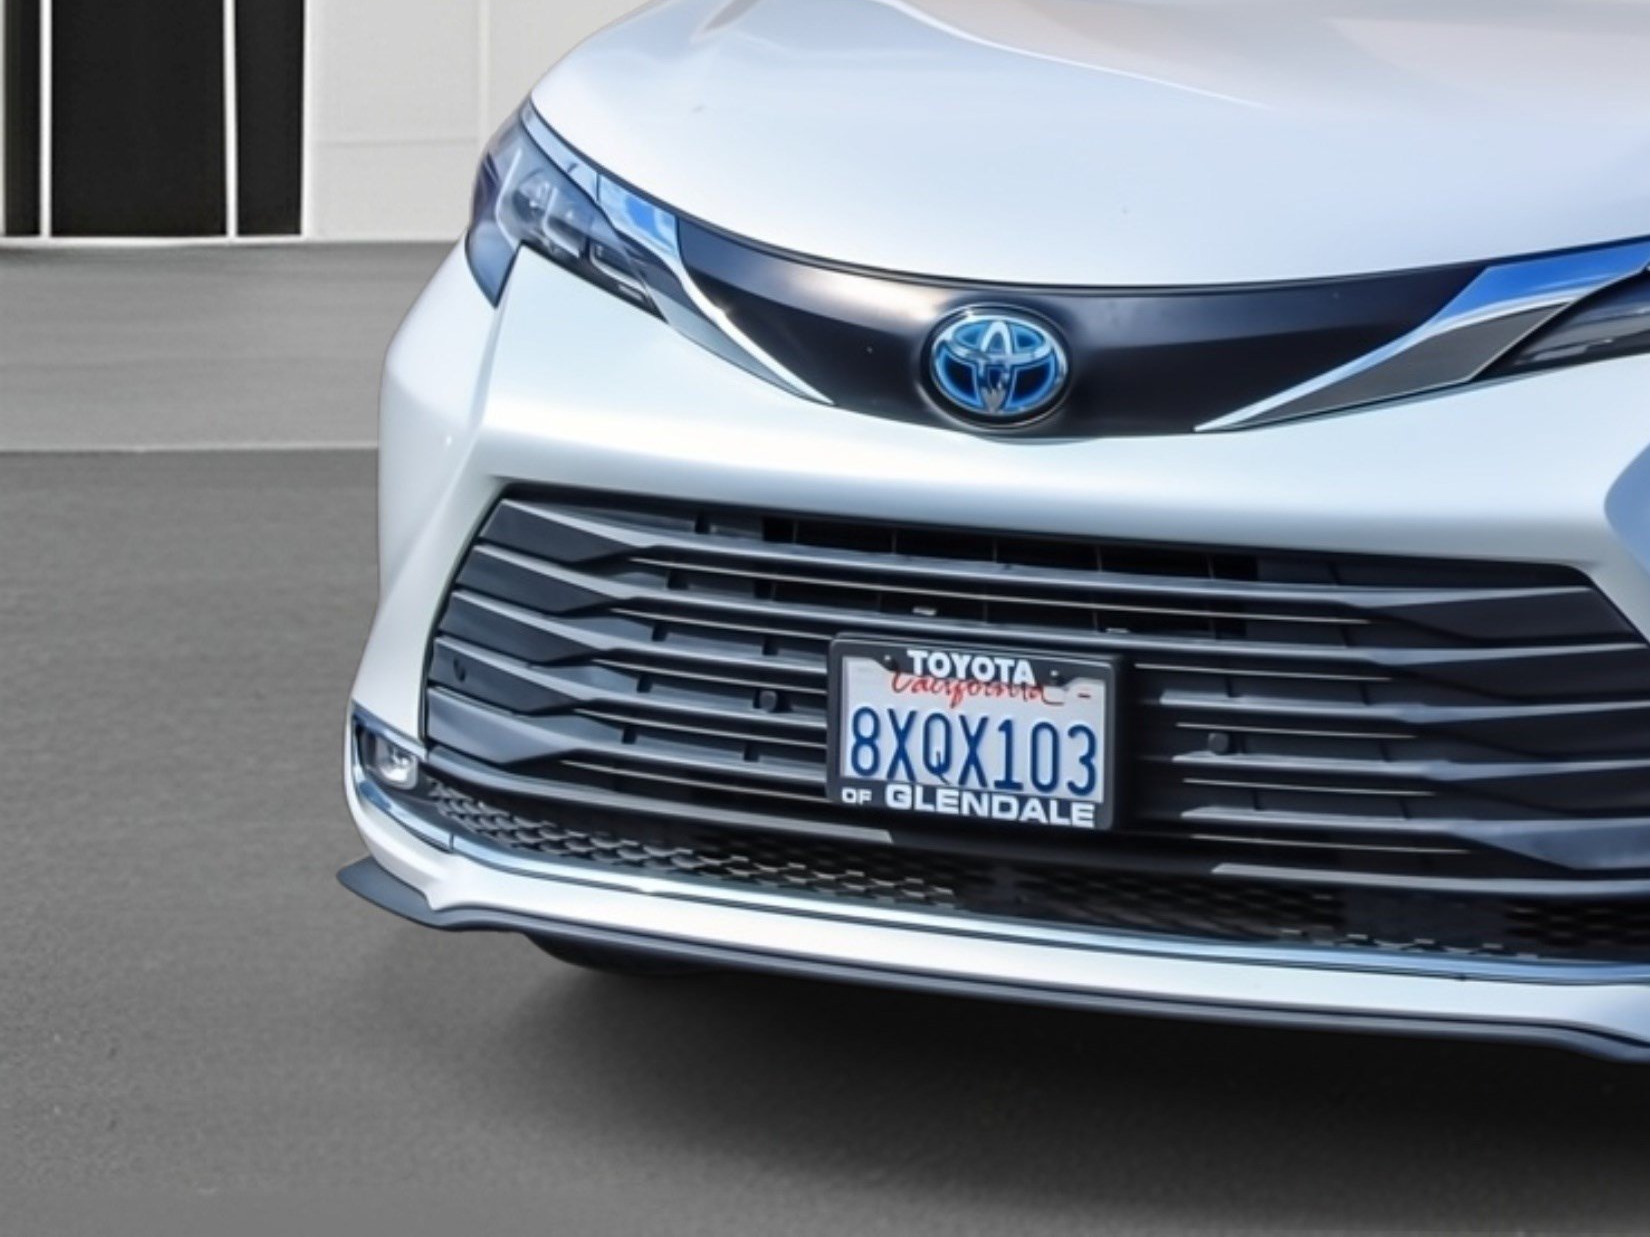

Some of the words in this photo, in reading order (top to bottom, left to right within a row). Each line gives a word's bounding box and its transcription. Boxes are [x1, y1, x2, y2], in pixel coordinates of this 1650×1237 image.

[906, 649, 1036, 685] TOYOTA
[850, 705, 1098, 797] 8XQX103
[841, 786, 873, 805] OF
[885, 782, 1096, 829] GLENDALE
